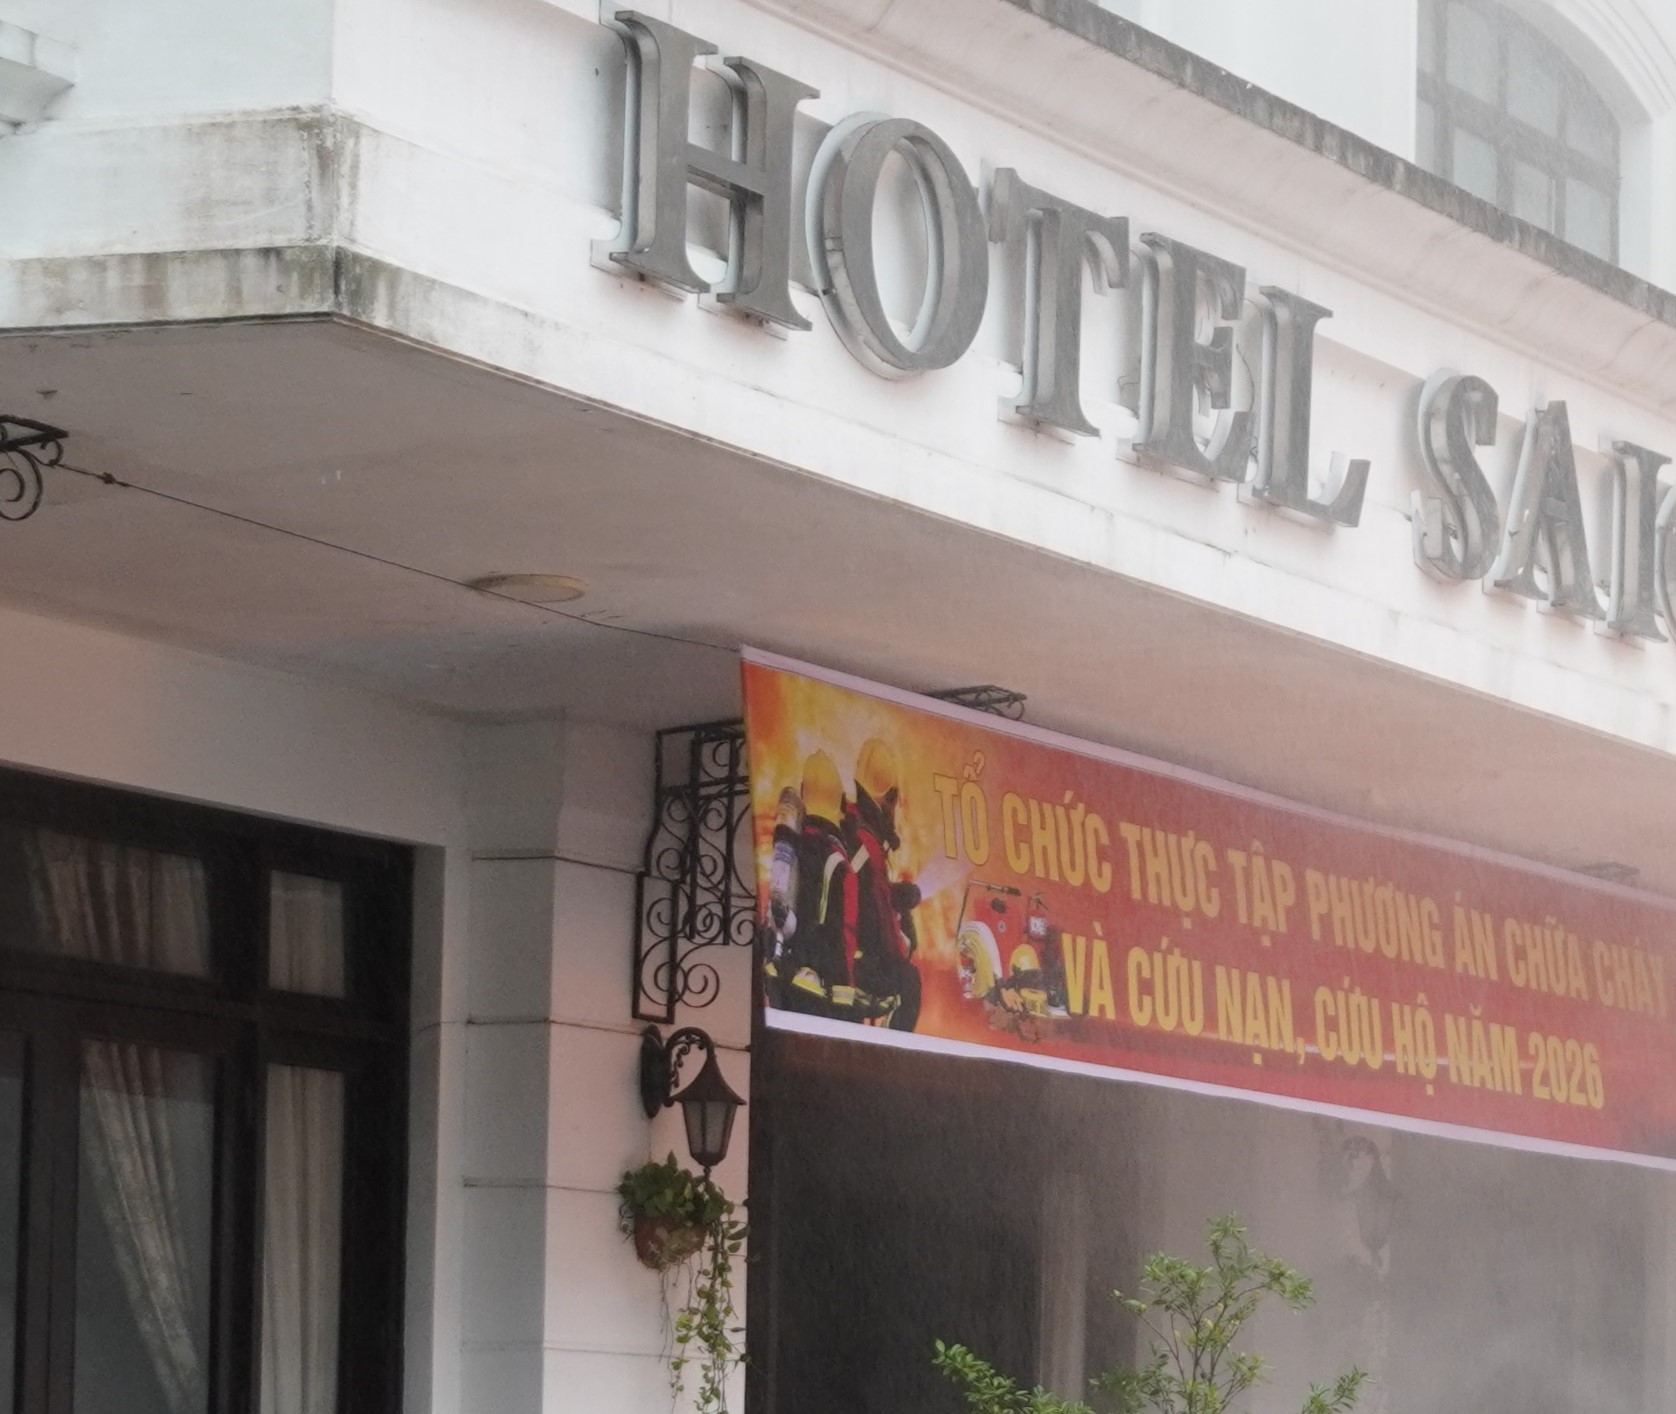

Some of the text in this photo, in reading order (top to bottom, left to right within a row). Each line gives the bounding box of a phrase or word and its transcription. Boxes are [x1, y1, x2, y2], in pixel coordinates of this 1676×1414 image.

[602, 9, 1371, 528] HOTEL
[932, 750, 1668, 1018] TỔ CHỨC THỰC TẬP PHƯƠNG ÁN CHỮA CHÁY
[1061, 921, 1606, 1110] VÀ CỨU NẠN, CỨU HỘ NĂM 2026
